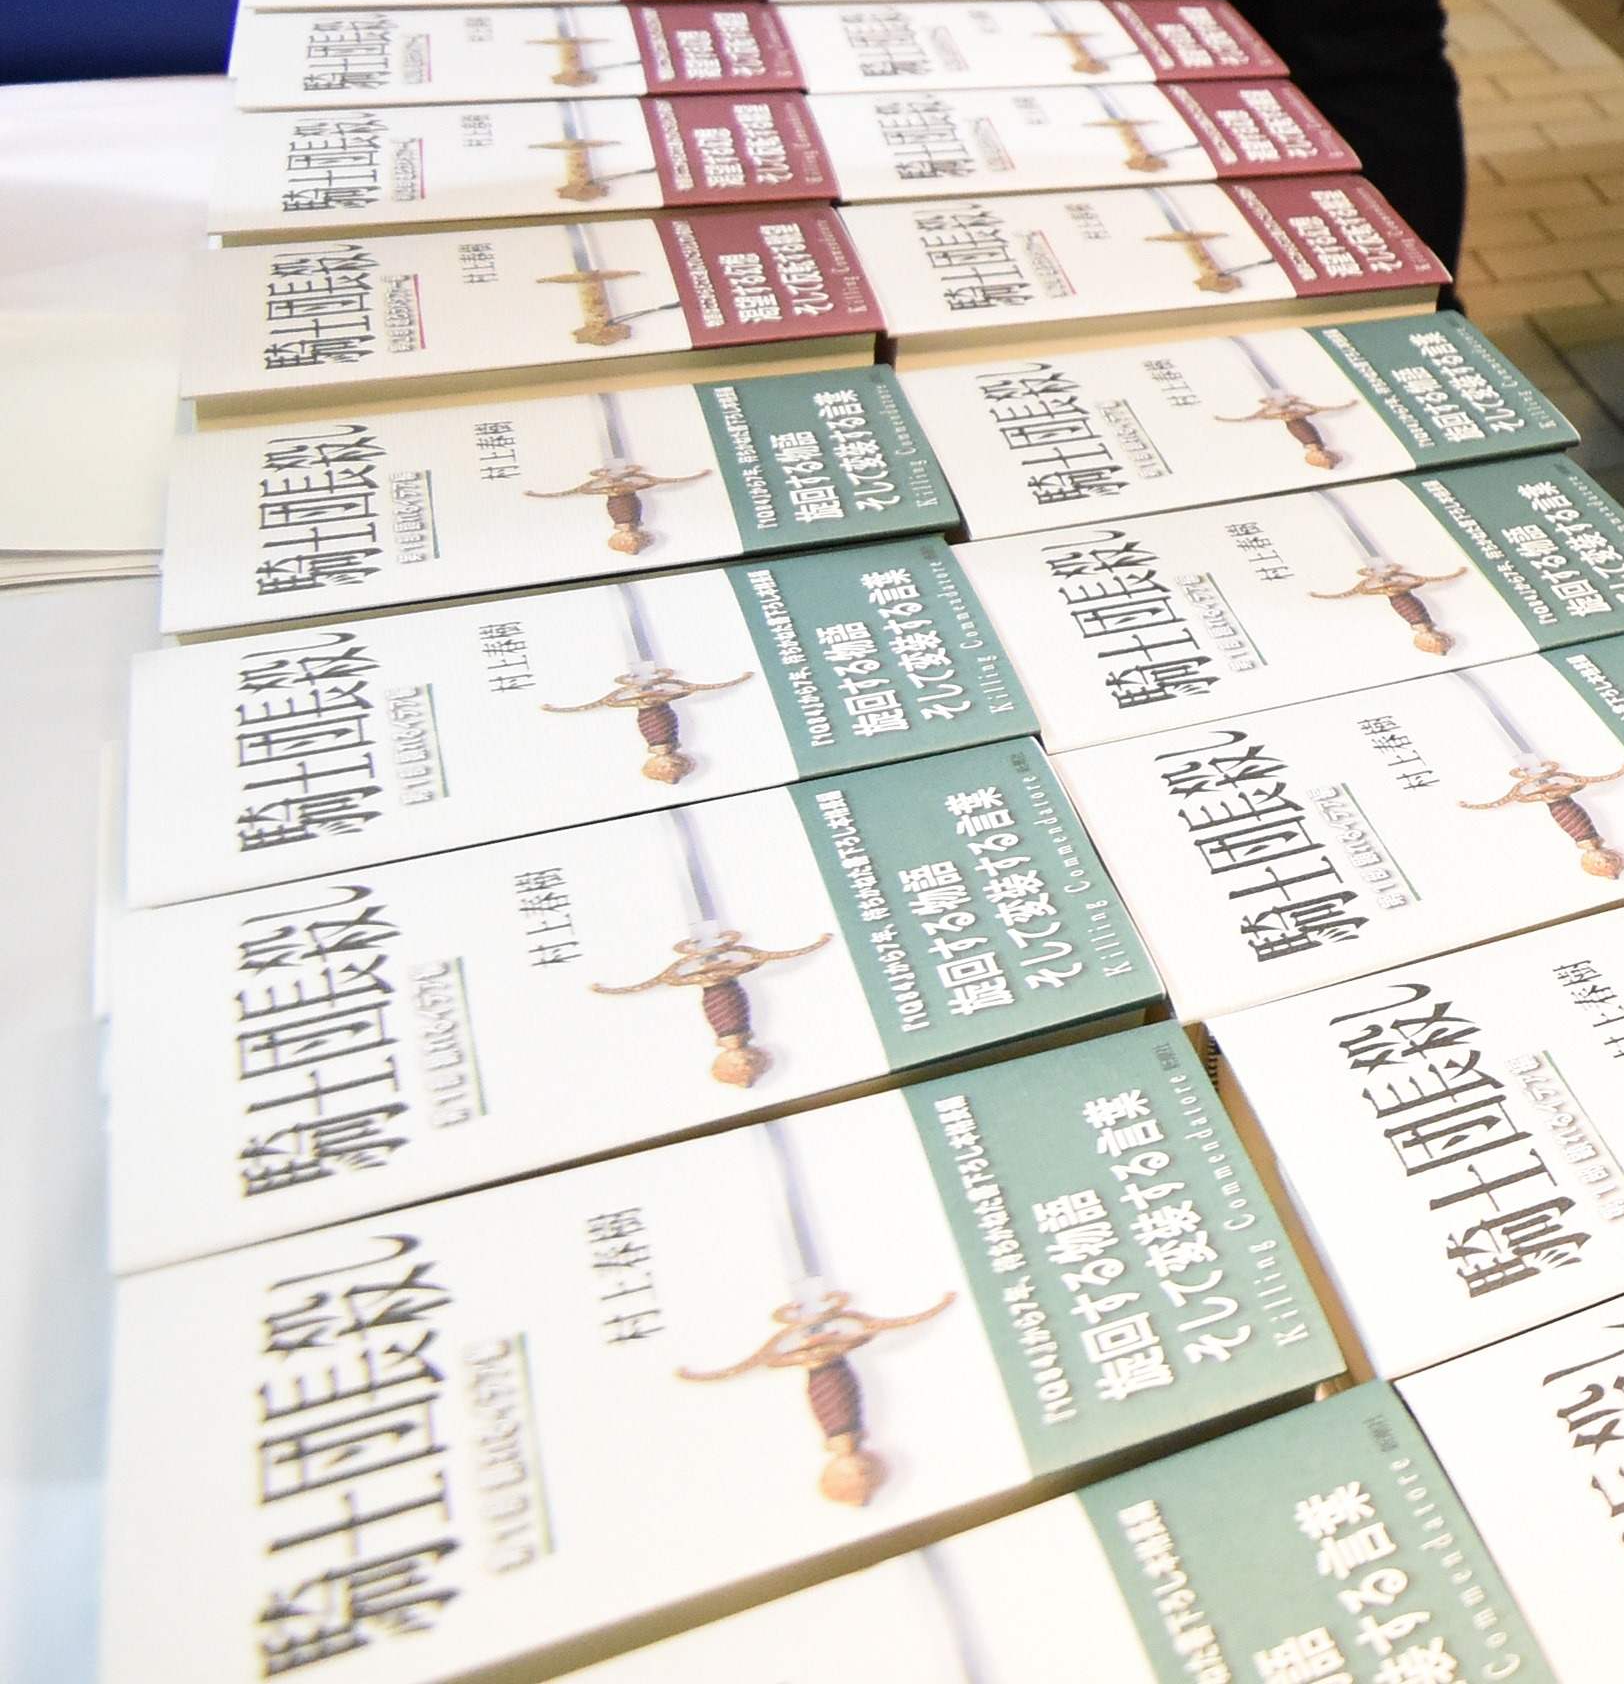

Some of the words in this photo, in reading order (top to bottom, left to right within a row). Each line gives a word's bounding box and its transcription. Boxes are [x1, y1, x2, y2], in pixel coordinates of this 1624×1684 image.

[264, 244, 378, 369] 騎士団長殺し
[460, 243, 497, 282] 村上春樹
[474, 421, 521, 477] 村上春樹
[812, 388, 900, 509] そして変装する言葉
[975, 362, 1129, 504] 騎士団長殺し
[1391, 366, 1486, 441] 旋回する物語
[257, 425, 386, 594] 騎士団長殺し
[770, 430, 844, 521] 旋回する物語
[1225, 522, 1295, 579] 村上春樹
[1501, 524, 1613, 616] 旋回する物語
[478, 621, 536, 691] 村上春樹
[815, 621, 910, 735] 旋回する物語
[859, 567, 972, 718] そして変装する言葉
[978, 655, 1015, 711] Killing
[1040, 529, 1220, 707] 騎士団長殺し
[237, 631, 383, 851] 騎士団長殺し
[1356, 715, 1439, 789] 村上春樹
[944, 785, 1081, 990] そして変装する言葉
[1021, 776, 1090, 894] Commendatore
[1154, 730, 1370, 961] 騎士団長殺し
[513, 867, 583, 966] 村上春樹
[899, 859, 1013, 1015] 旋回する物語
[1084, 902, 1130, 979] Killing
[236, 886, 411, 1198] 騎士団長殺し
[1169, 1074, 1254, 1232] Commendatore
[1329, 982, 1592, 1296] 騎士団長殺し
[586, 1206, 667, 1342] 村上春樹
[1082, 1087, 1250, 1364] そして変装する言葉
[1033, 1187, 1172, 1400] 旋回する物語
[1249, 1242, 1306, 1348] Killing
[256, 1236, 463, 1680] 騎士団長殺し
[1391, 1457, 1513, 1677] Commendatore
